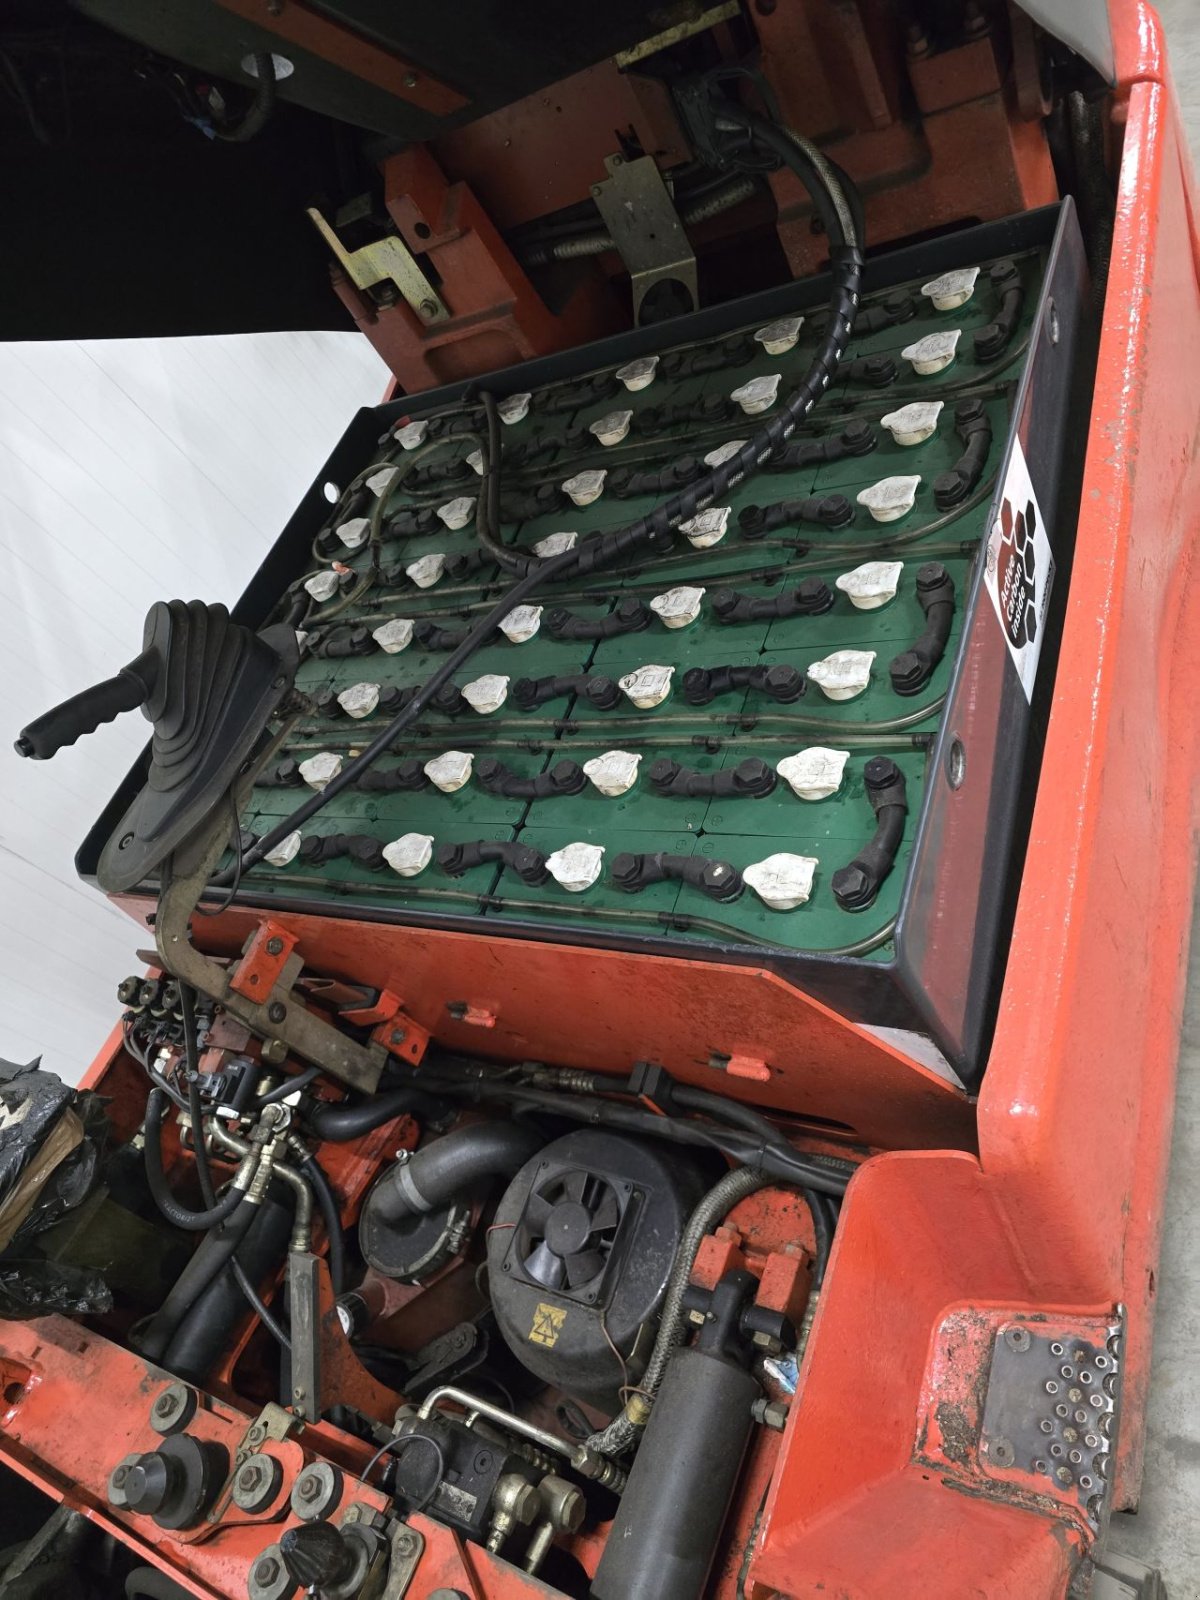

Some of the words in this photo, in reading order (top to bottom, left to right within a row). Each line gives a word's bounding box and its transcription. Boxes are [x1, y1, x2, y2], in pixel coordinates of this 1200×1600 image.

[1001, 554, 1015, 608] Active
[1007, 562, 1022, 622] Carbon
[1011, 586, 1026, 639] inside
